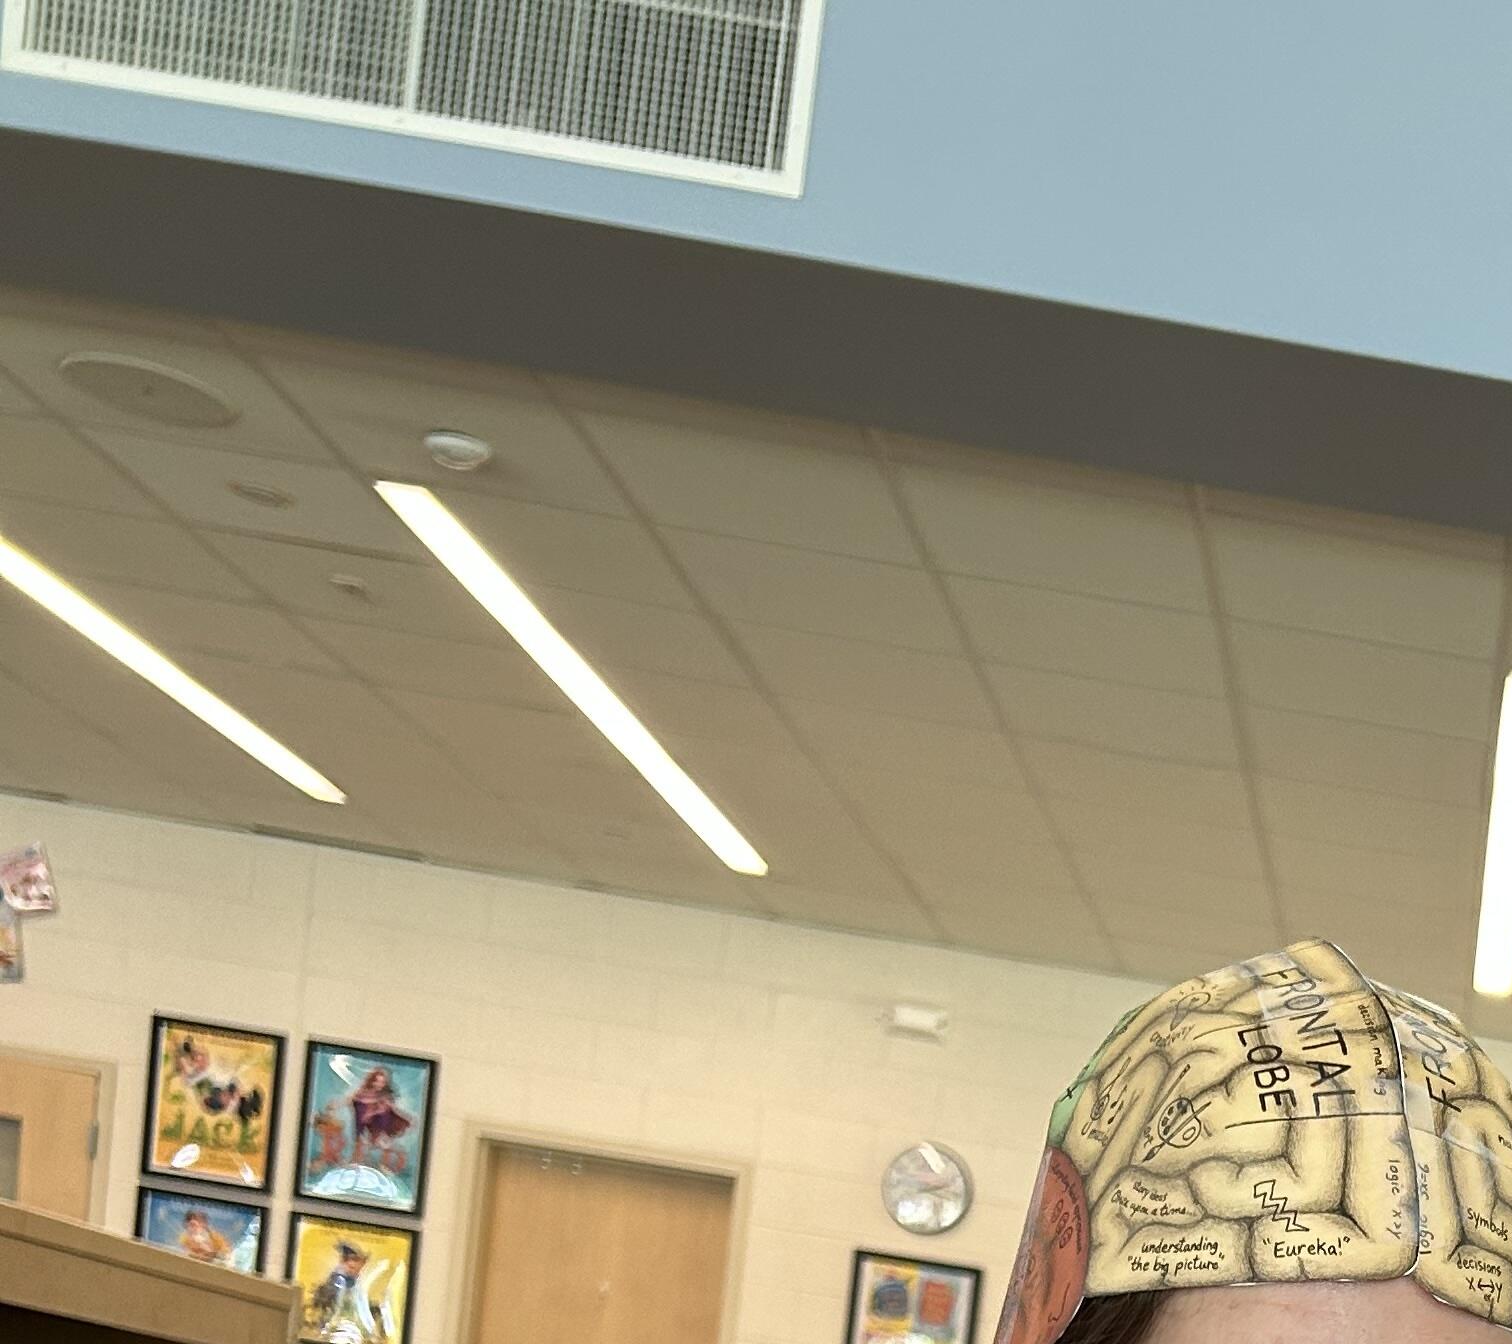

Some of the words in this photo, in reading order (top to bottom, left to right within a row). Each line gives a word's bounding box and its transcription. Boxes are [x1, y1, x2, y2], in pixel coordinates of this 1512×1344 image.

[1357, 1003, 1379, 1043] decision
[1260, 966, 1356, 1117] FRONTAL
[1237, 1024, 1297, 1113] LOBE
[1385, 1158, 1402, 1197] logic
[1467, 1207, 1509, 1242] symbols
[1141, 1239, 1219, 1256] understanding
[1262, 1236, 1351, 1259] "Eureka!"
[1456, 1252, 1503, 1277] decisions
[1152, 1255, 1170, 1276] big
